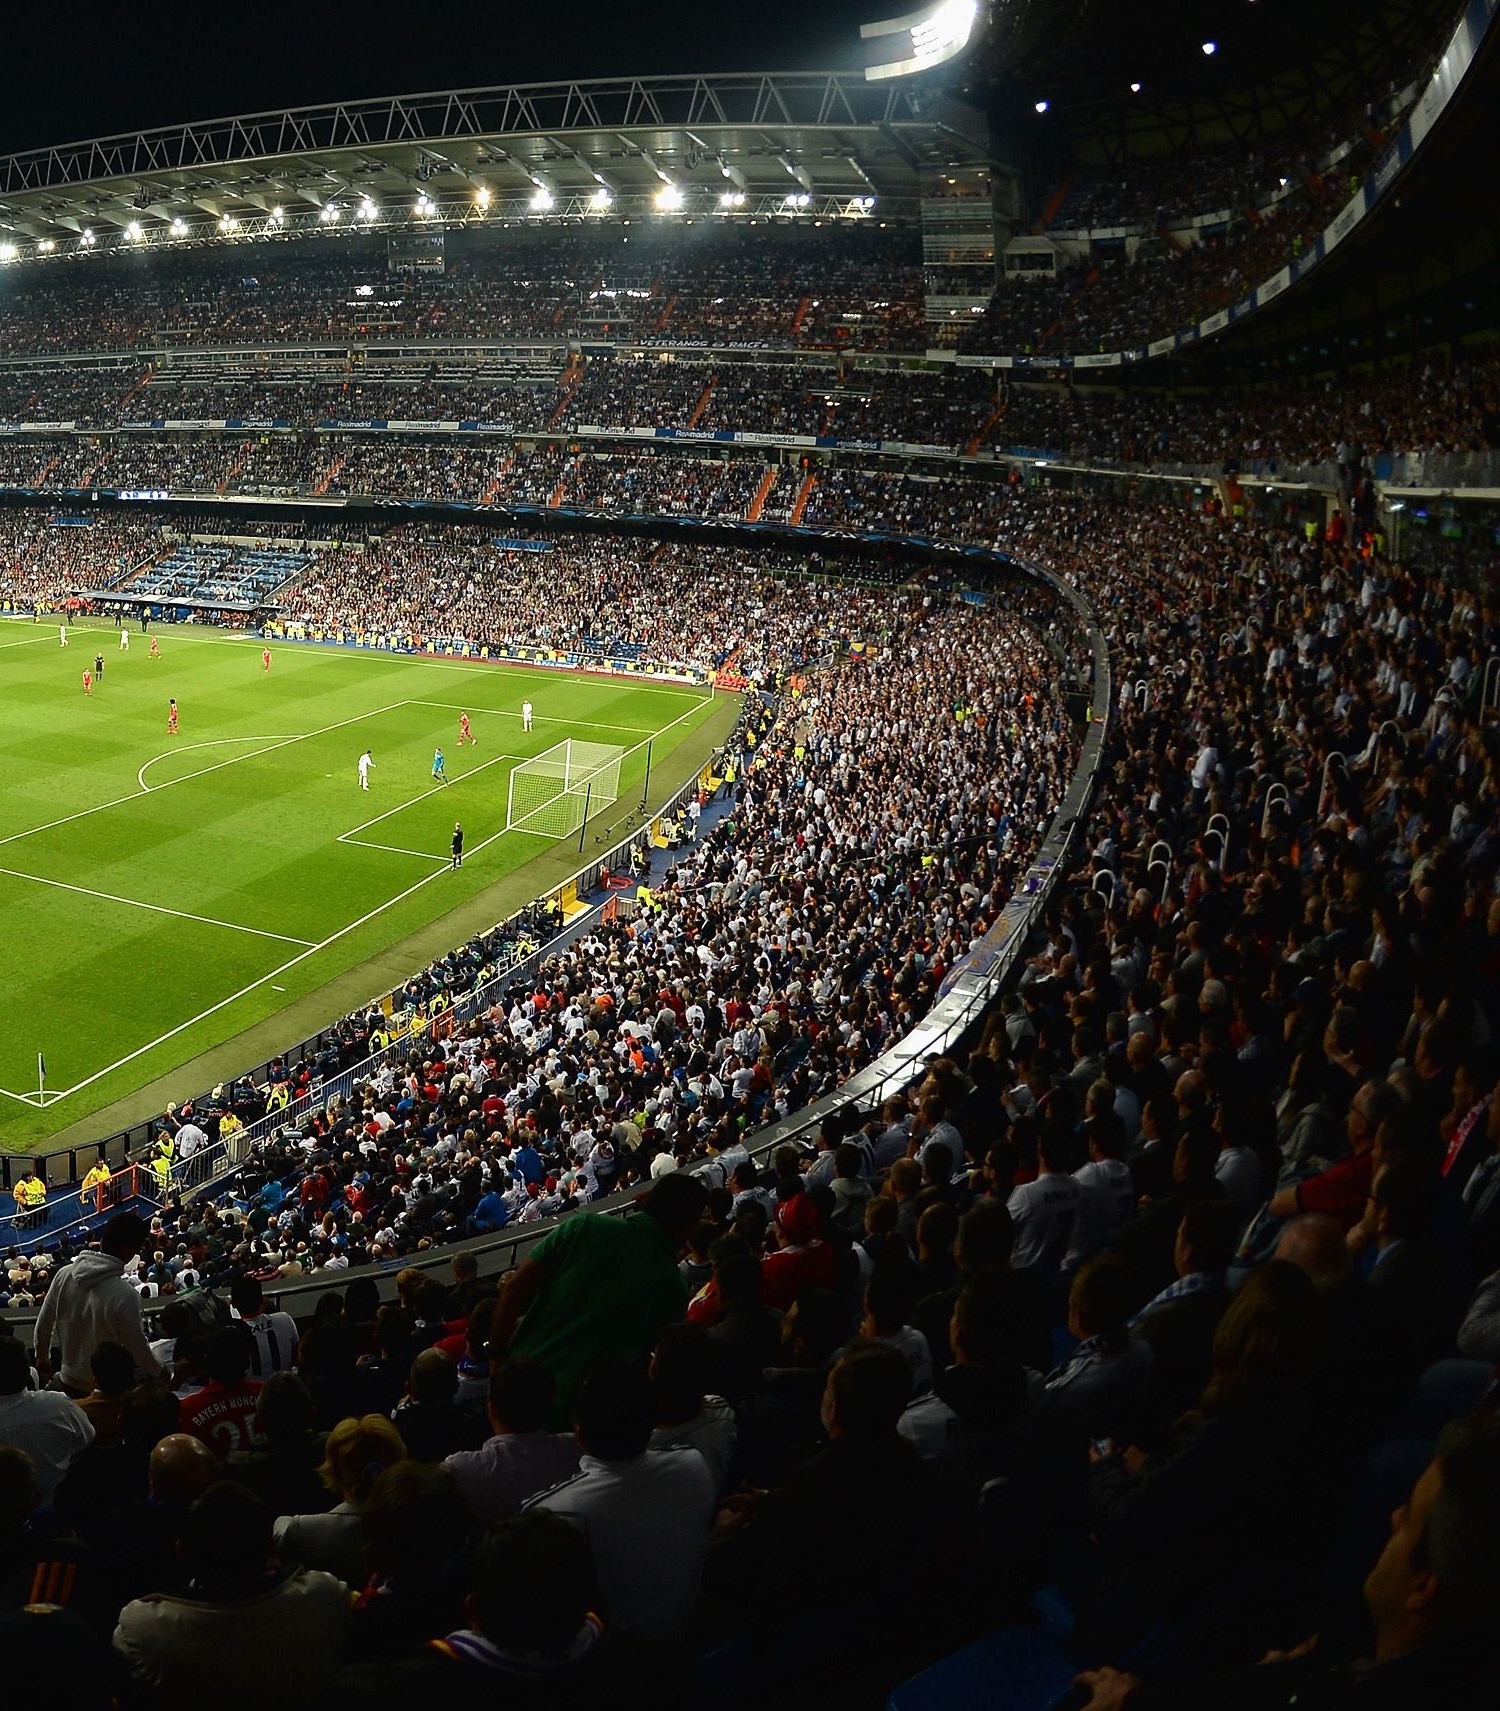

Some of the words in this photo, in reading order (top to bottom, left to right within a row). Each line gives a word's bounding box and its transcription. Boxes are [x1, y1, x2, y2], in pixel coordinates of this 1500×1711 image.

[337, 420, 372, 429] Realmadrid
[406, 421, 441, 430] Realmadrid
[476, 422, 514, 432] Realmadrid
[675, 429, 716, 439] Reamadrid
[754, 434, 796, 444] Realmadrid
[252, 1319, 274, 1334] ALE
[191, 1400, 228, 1427] BAYERN
